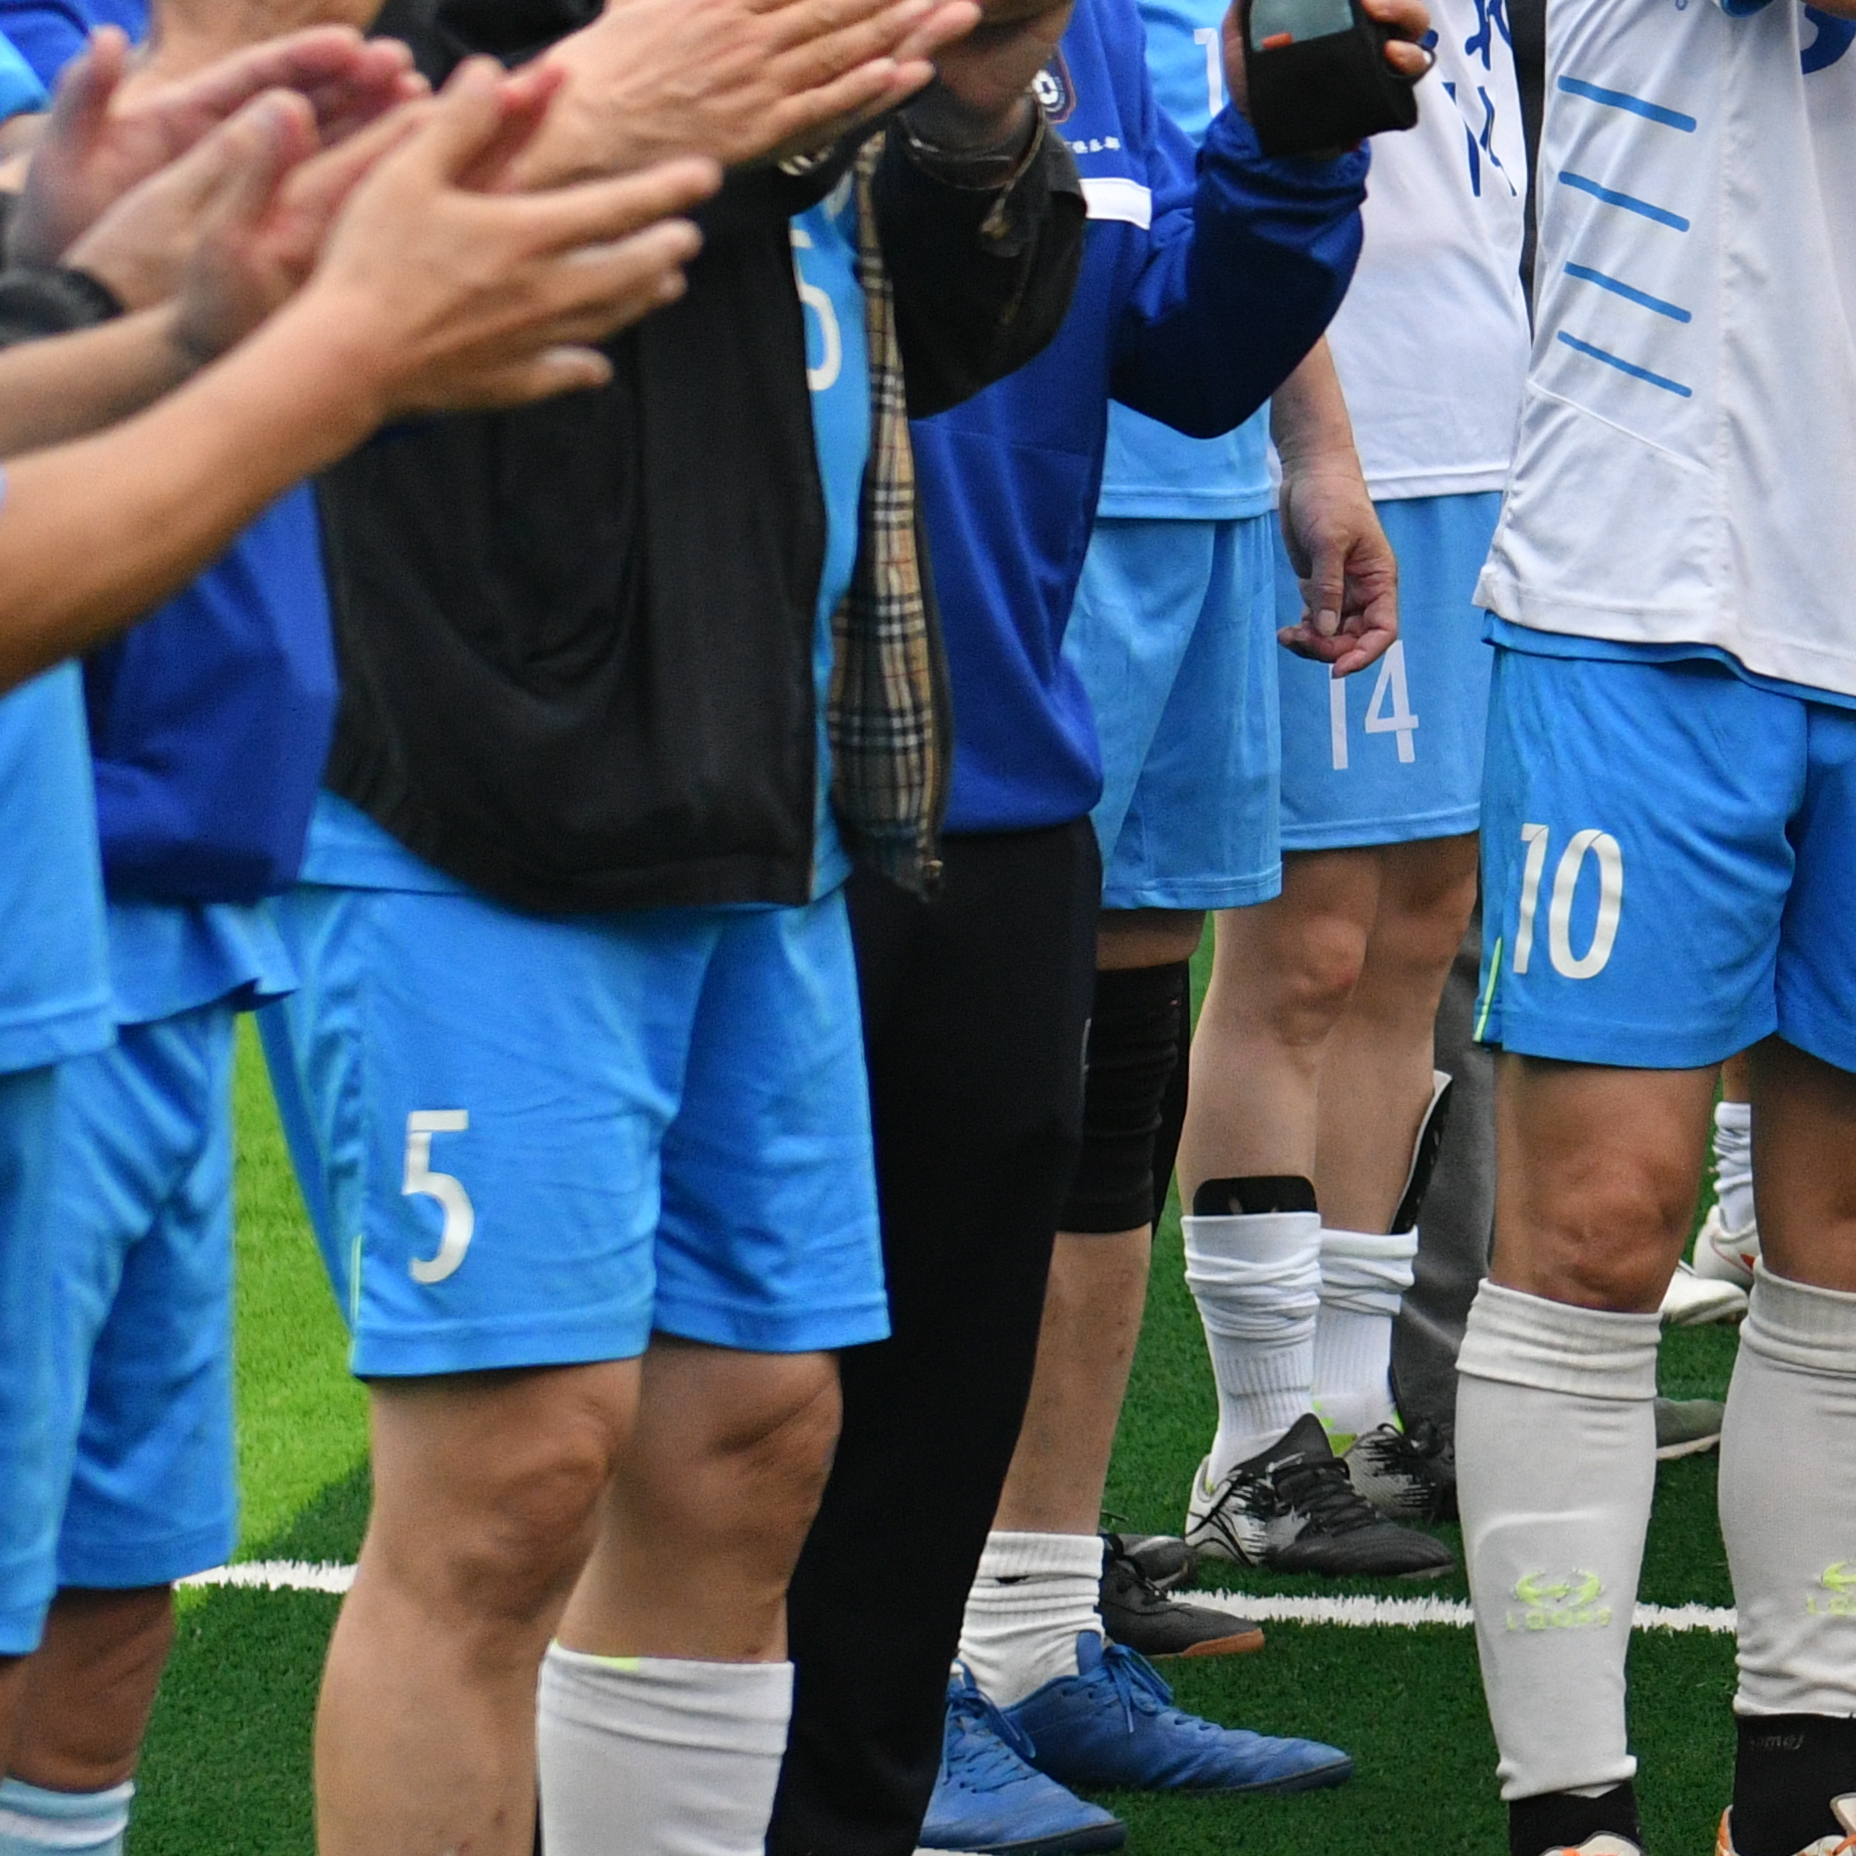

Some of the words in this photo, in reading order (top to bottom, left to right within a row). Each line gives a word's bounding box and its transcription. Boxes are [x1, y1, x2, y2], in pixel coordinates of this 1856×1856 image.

[1328, 639, 1420, 771] 14
[1511, 821, 1624, 981] 10
[401, 1109, 475, 1285] 5
